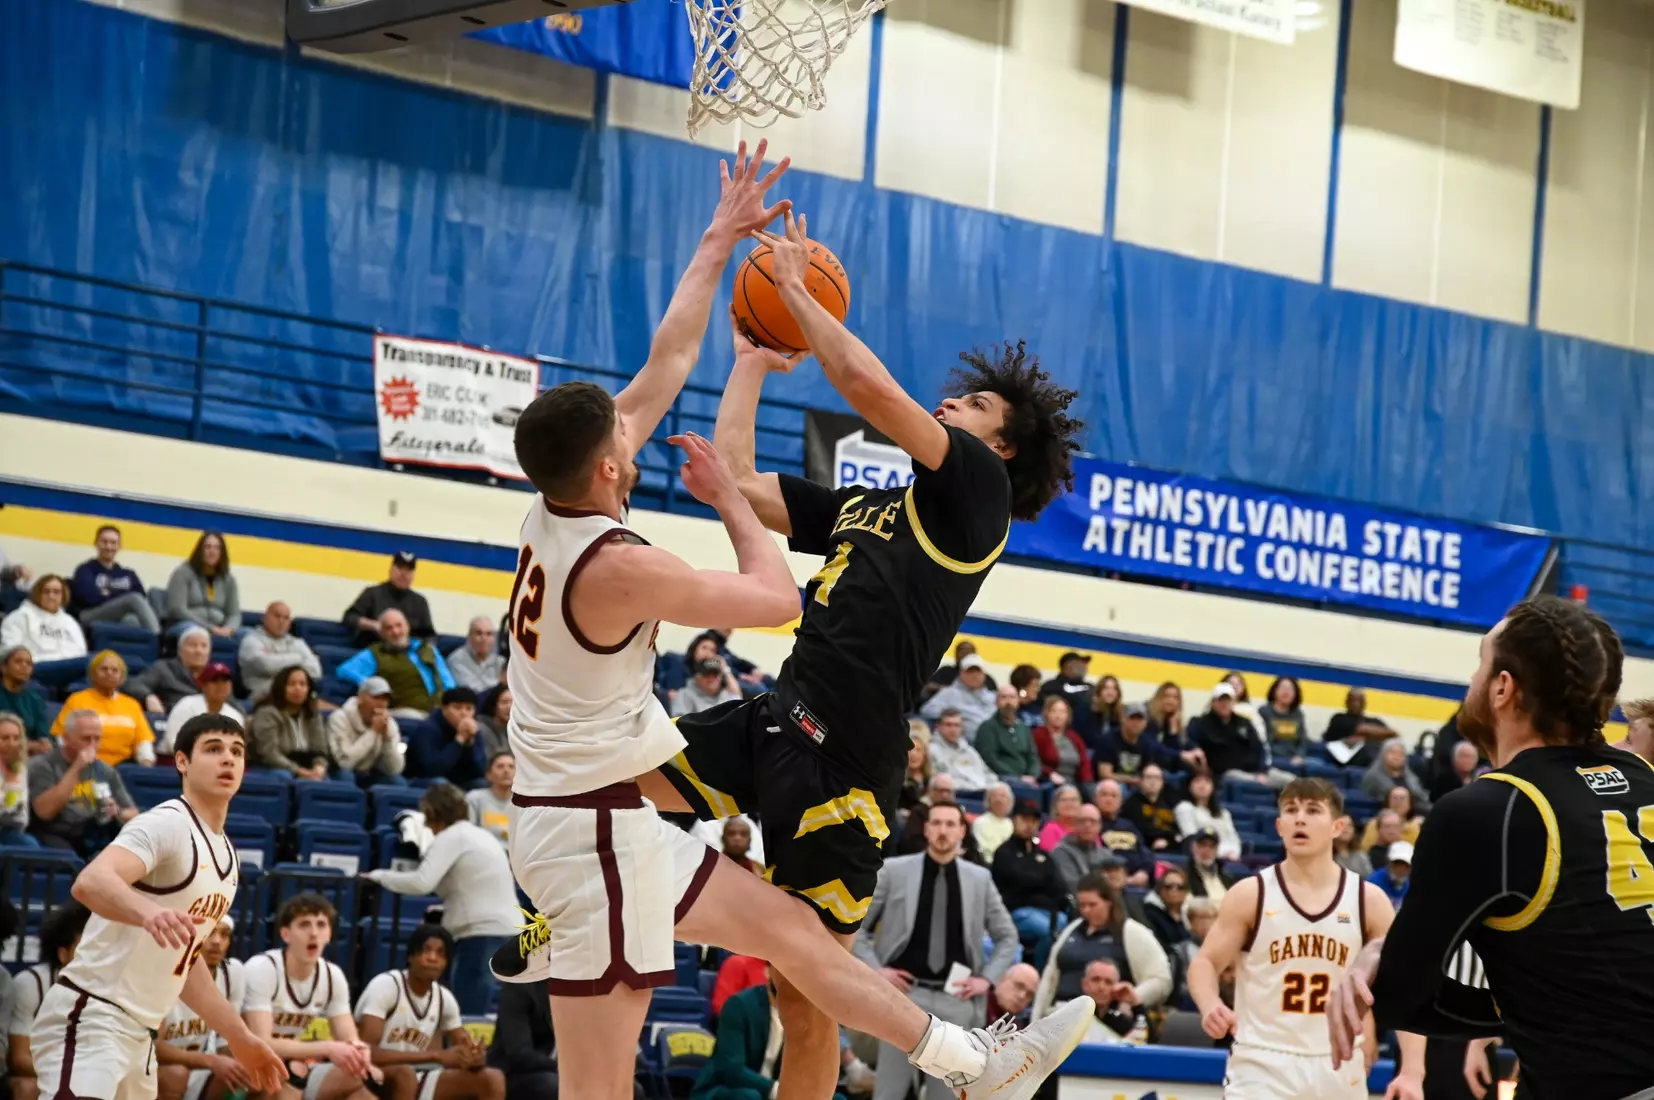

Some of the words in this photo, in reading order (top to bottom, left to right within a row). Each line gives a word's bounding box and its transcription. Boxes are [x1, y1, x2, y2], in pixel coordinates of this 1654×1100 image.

[382, 342, 481, 375] Transparency
[484, 362, 495, 376] &
[499, 360, 532, 383] Trust
[1089, 472, 1348, 551] PENNSYLVANIA
[1361, 519, 1462, 570] STATE
[1081, 515, 1246, 576] ATHLETIC
[1255, 541, 1462, 609] CONFERENCE
[508, 542, 546, 662] 12
[1583, 770, 1627, 788] PSAC
[1269, 933, 1349, 968] GANNON
[1282, 972, 1330, 1014] 22
